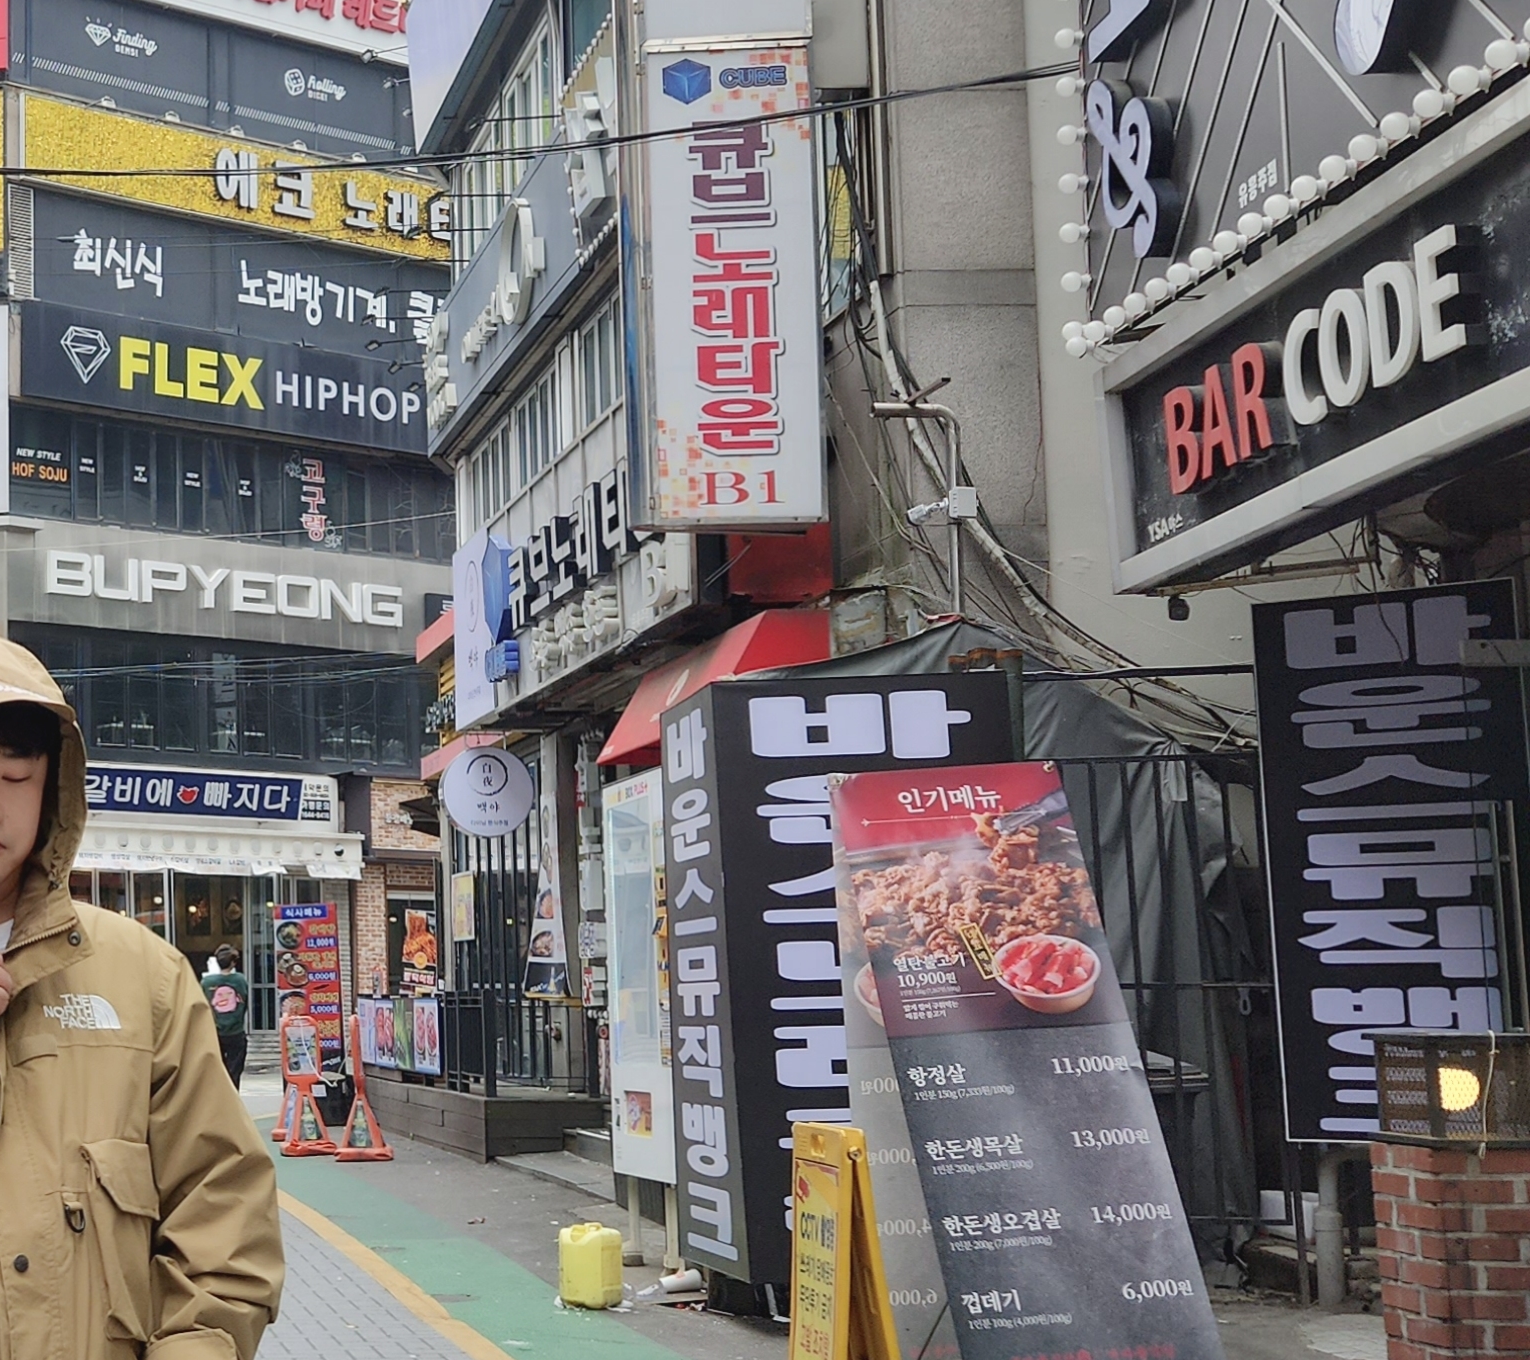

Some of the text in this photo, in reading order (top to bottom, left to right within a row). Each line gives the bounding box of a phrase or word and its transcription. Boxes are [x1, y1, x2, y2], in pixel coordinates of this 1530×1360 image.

[113, 28, 159, 56] Finding
[307, 75, 347, 101] Rolling
[717, 66, 788, 87] CUBE
[214, 147, 317, 221] 에코
[1237, 157, 1279, 211] 유흥주점
[72, 227, 165, 299] 최신식
[686, 117, 784, 454] 큐브노래타운
[1163, 224, 1468, 496] BAR CODE
[118, 334, 265, 411] FLEX
[274, 369, 422, 426] HIPHOP
[11, 460, 69, 483] HOF SOJU
[15, 447, 63, 463] NEW STYLE
[700, 470, 782, 506] B1
[507, 465, 631, 631] 큐브노래타
[44, 549, 404, 628] BUPYEONG
[85, 774, 291, 813] 갈비에 빠지다
[896, 784, 1002, 814] 인기메뉴
[892, 951, 967, 972] 열탄불고기
[897, 971, 957, 989] 10,900원
[42, 1004, 94, 1020] NORTH
[59, 993, 91, 1007] THE
[60, 1018, 97, 1031] FACE
[906, 1054, 1130, 1087] 항정살 11,000원
[923, 1126, 1153, 1161] 한돈생목살 13,000원
[799, 1209, 820, 1241] CCTV
[941, 1201, 1174, 1238] 한돈생오겹살 14,000원
[959, 1278, 1196, 1316] 껍데기 6,000원
